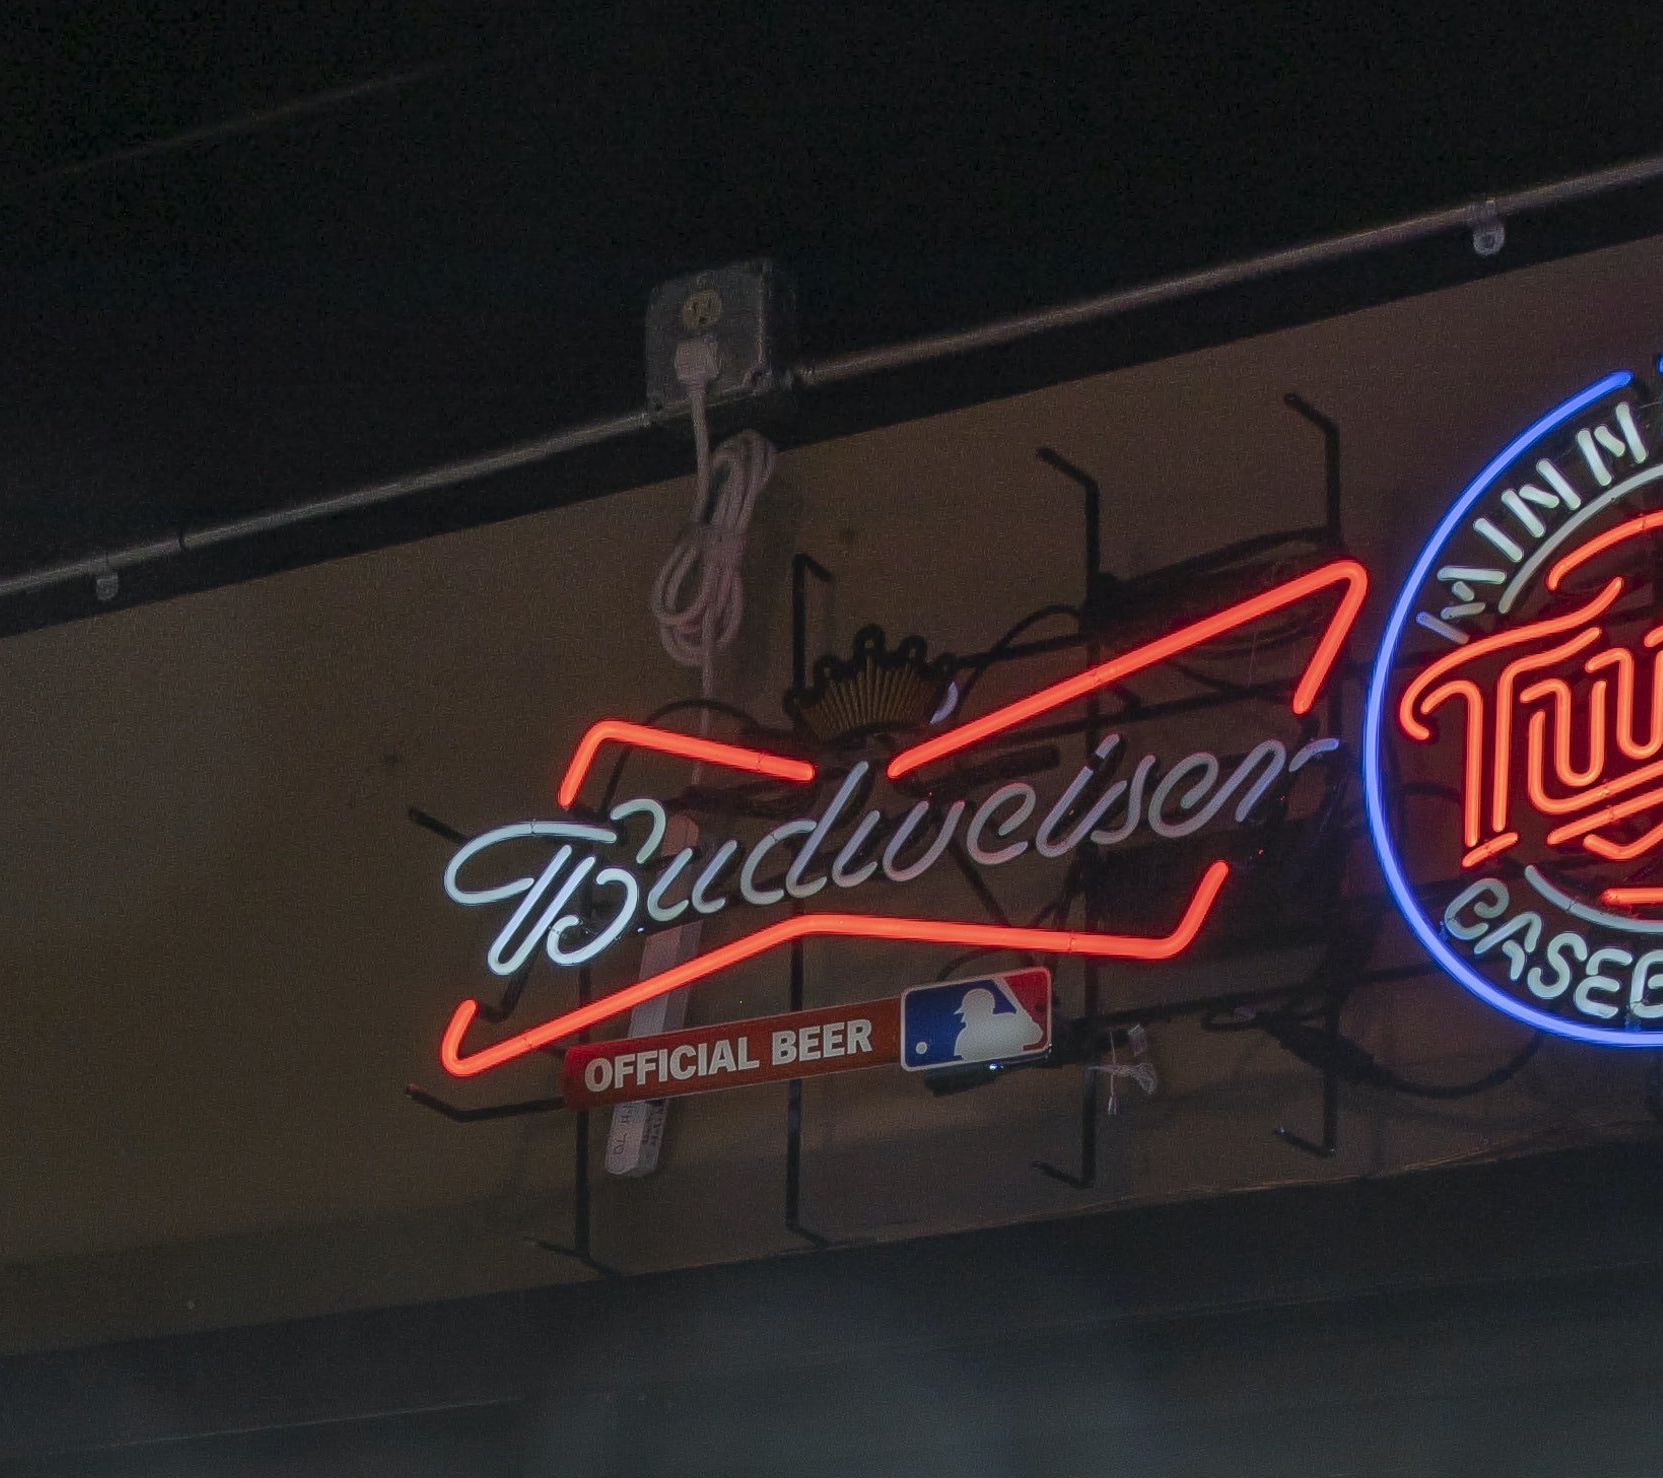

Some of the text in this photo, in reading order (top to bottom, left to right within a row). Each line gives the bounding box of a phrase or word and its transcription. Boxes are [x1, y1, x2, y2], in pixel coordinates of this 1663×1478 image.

[443, 732, 1340, 976] Budweiser
[584, 1018, 873, 1093] OFFICIAL BEER
